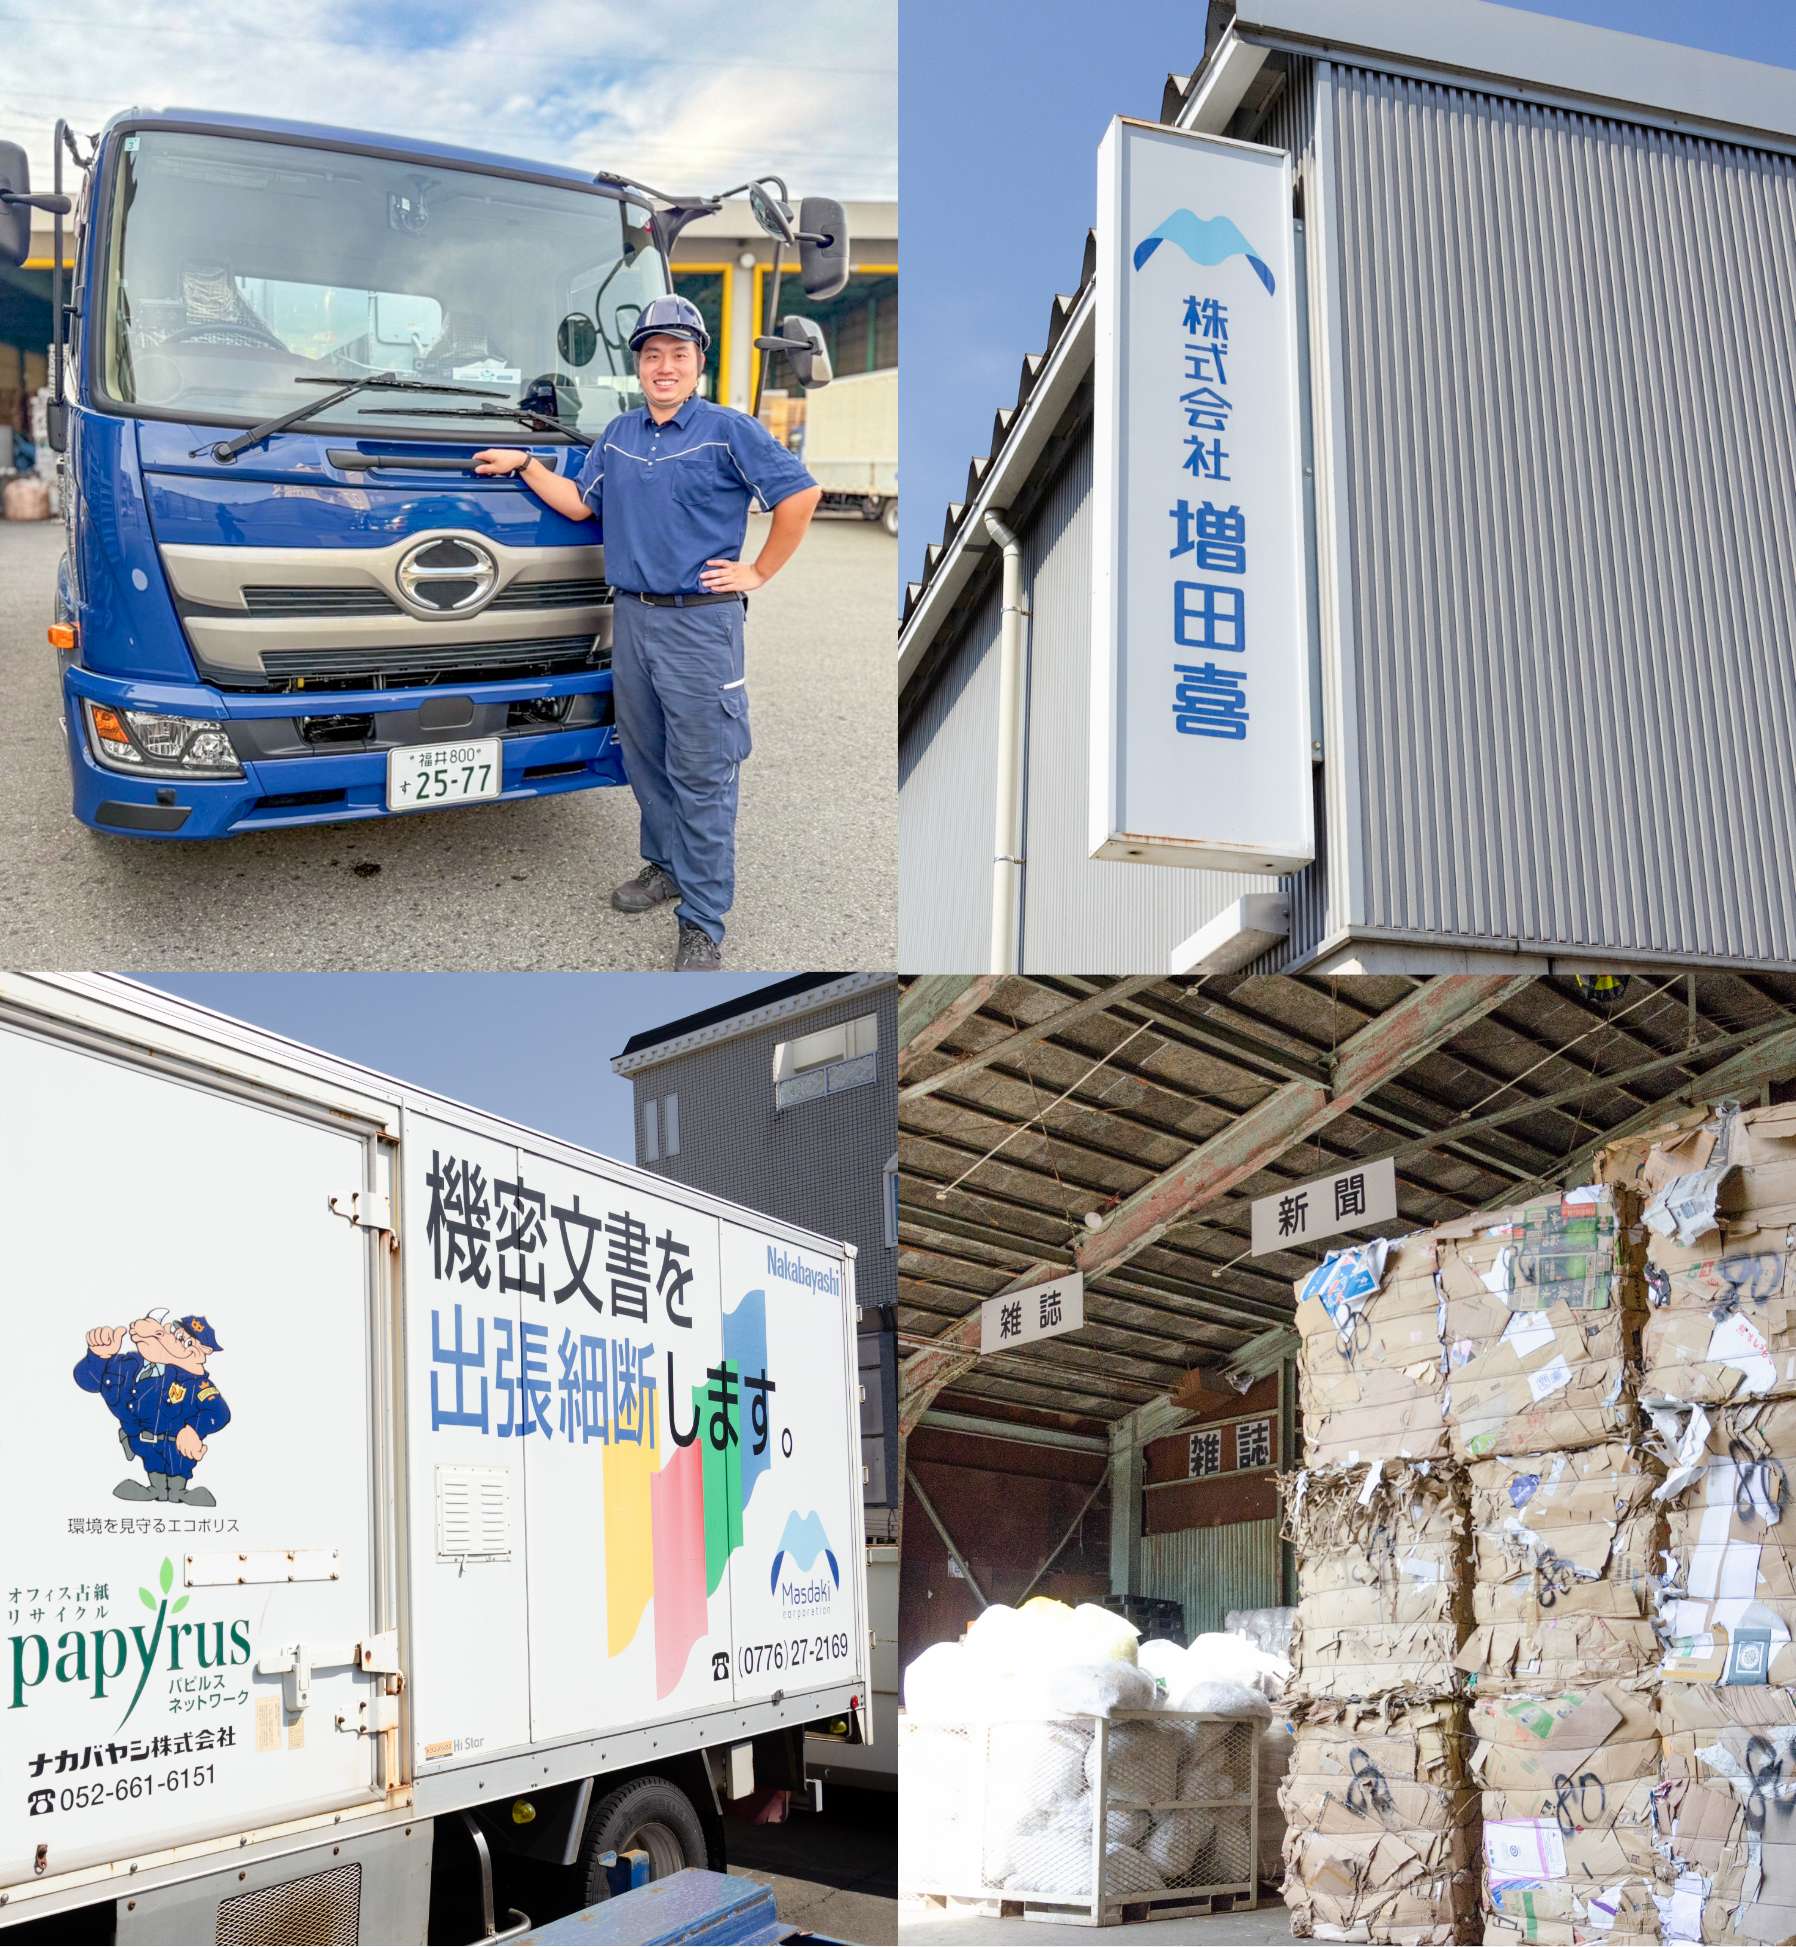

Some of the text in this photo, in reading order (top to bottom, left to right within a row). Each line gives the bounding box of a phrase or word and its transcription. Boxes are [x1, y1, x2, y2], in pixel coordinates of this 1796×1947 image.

[1170, 295, 1249, 741] 株式会社増田喜
[400, 764, 491, 800] す 25-77
[418, 747, 475, 768] 福井800
[1277, 1173, 1367, 1237] 新聞
[426, 1149, 695, 1329] 機密文書を
[767, 1245, 840, 1297] Nakabayashi
[1000, 1290, 1062, 1340] 雑誌
[430, 1304, 793, 1458] 出張細断します。
[1190, 1423, 1269, 1476] 雑誌
[8, 1583, 110, 1605] オフィス古紙
[8, 1604, 109, 1626] リサイクル
[782, 1579, 831, 1606] Masdaki
[8, 1599, 250, 1737] papyrus
[738, 1632, 848, 1678] (0776)27-2169
[169, 1689, 249, 1714] ネットワーク
[28, 1725, 236, 1778] ナカバヤシ株式会社
[60, 1764, 214, 1811] 052-661-6151
